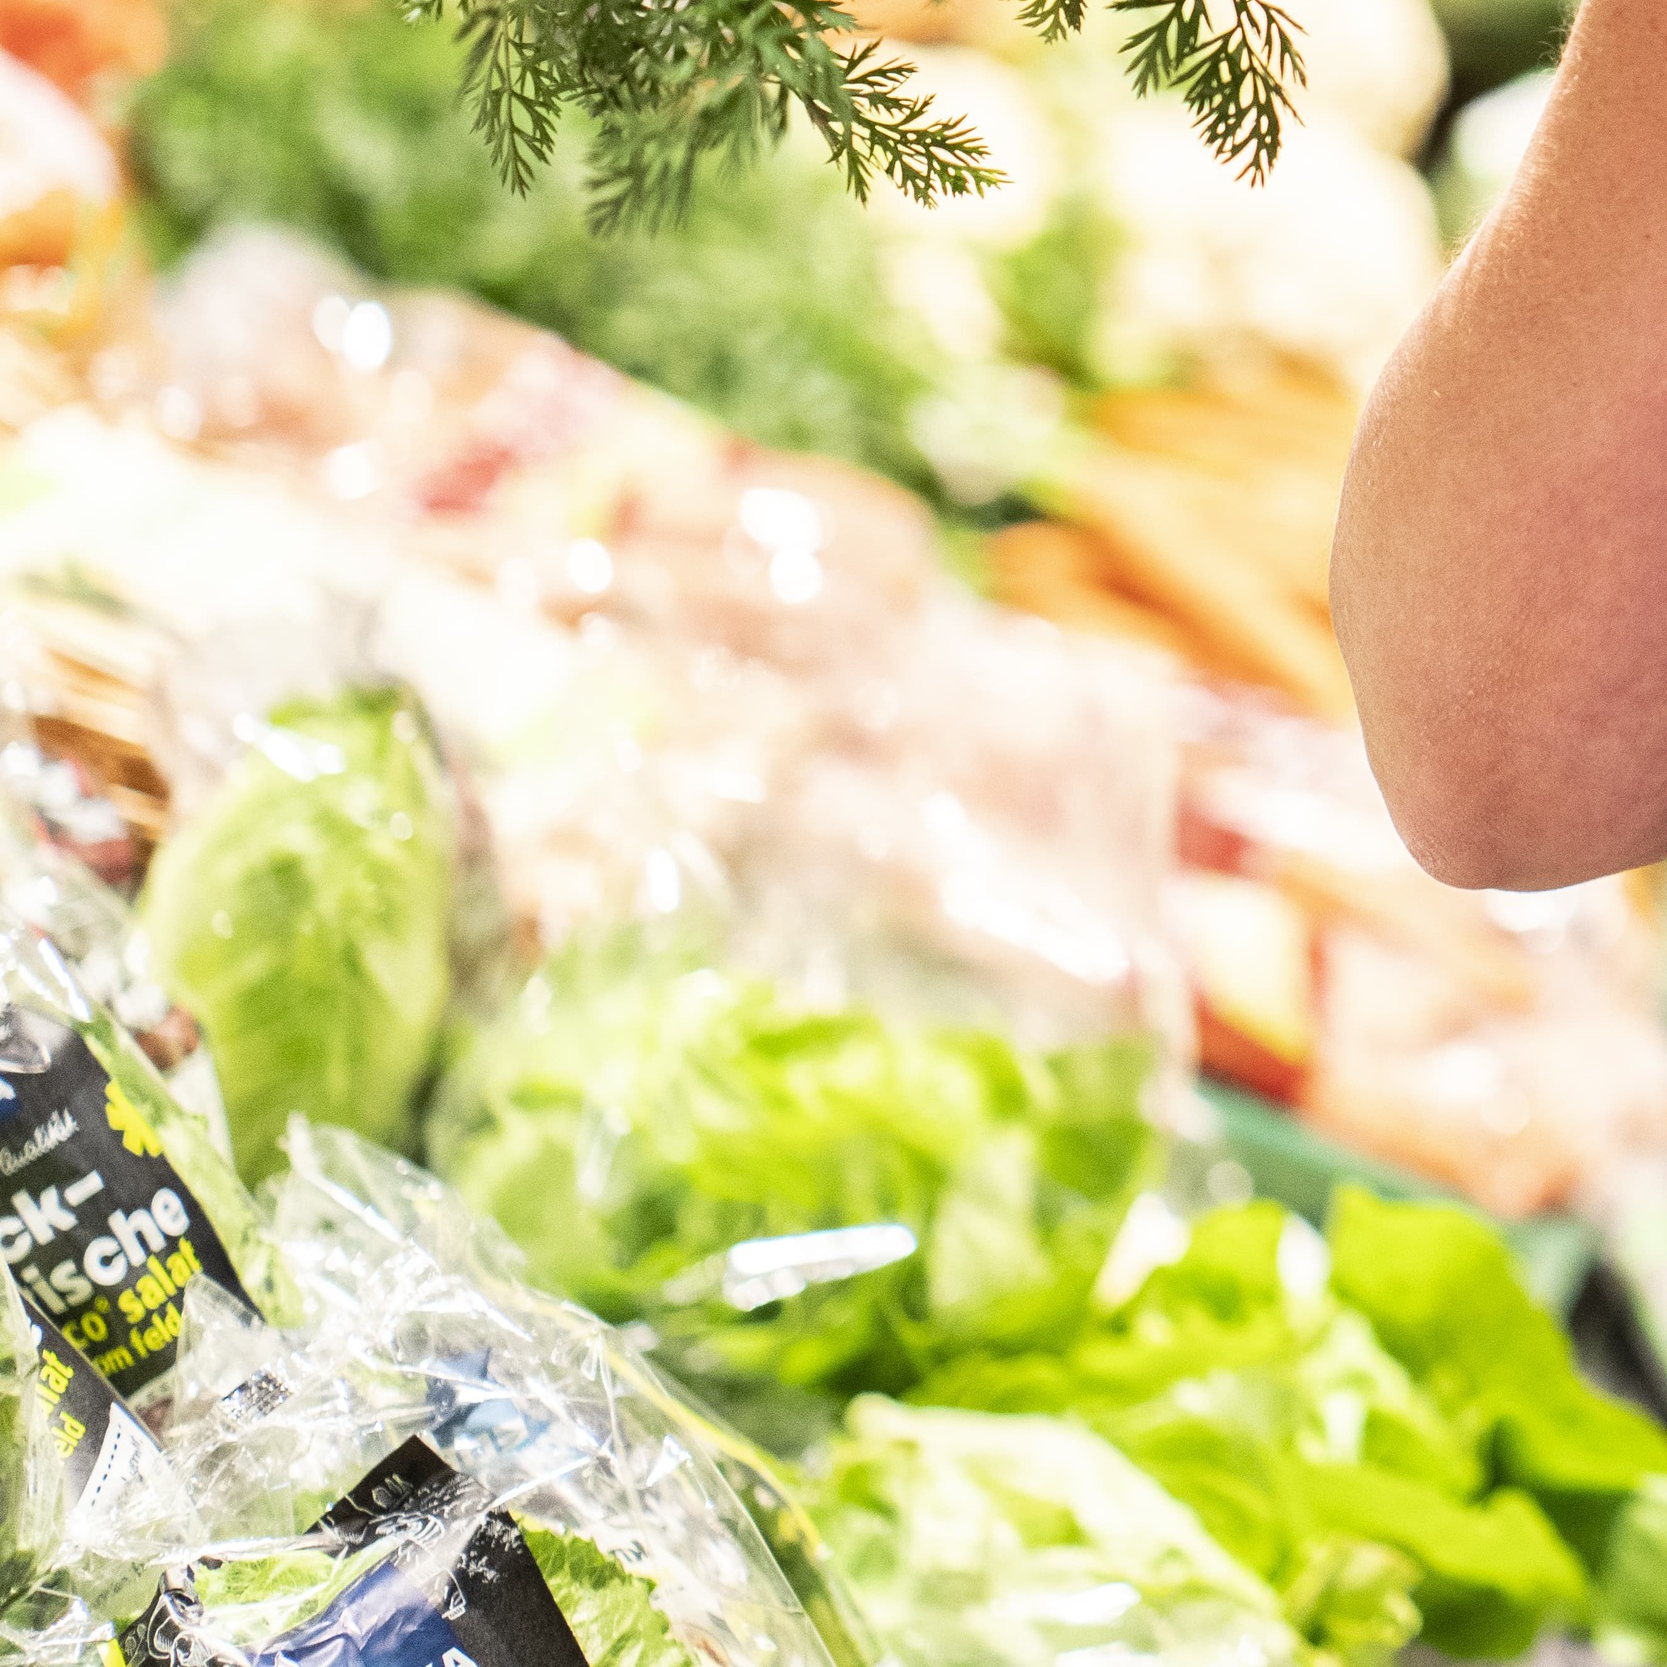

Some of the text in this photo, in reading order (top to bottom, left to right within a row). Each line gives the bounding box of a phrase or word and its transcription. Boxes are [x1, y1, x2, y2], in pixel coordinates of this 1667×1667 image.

[0, 1169, 105, 1264] ck-
[19, 1187, 190, 1316] ische
[118, 1236, 202, 1324] salat
[50, 1411, 87, 1459] eld
